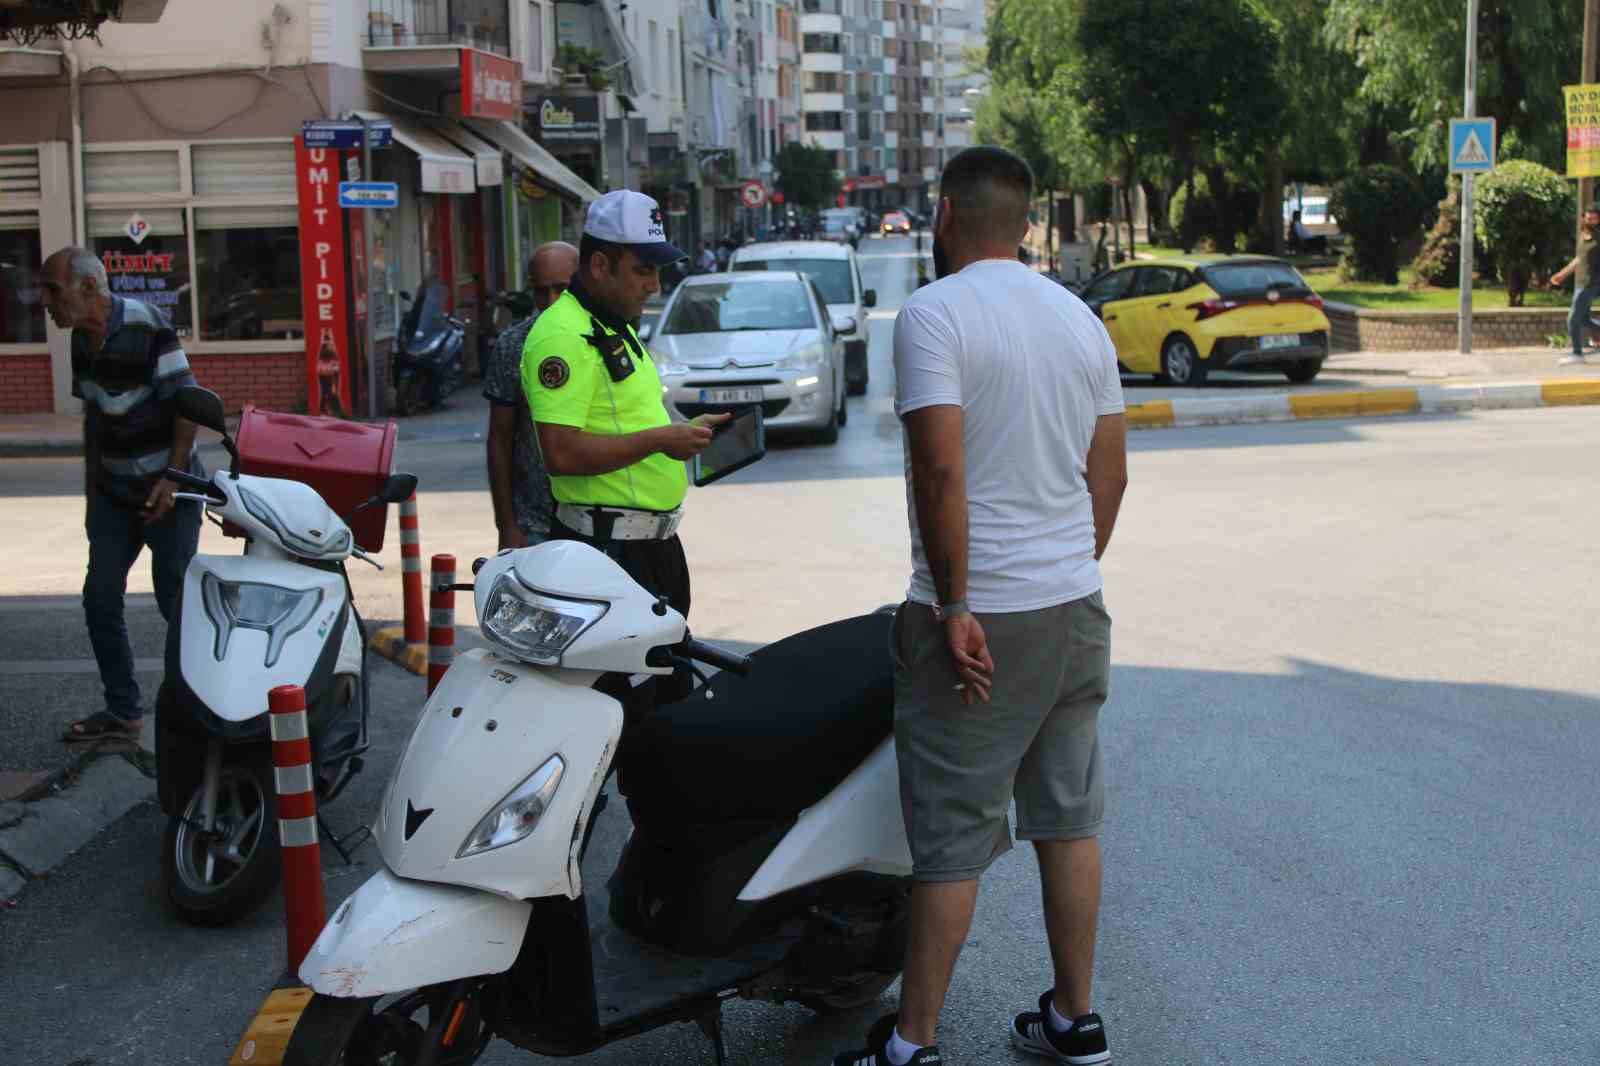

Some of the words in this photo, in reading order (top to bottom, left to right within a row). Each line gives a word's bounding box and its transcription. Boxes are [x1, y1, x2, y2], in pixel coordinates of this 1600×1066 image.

[1569, 115, 1600, 126] FUA
[305, 131, 335, 140] KIBRIS
[1077, 1023, 1100, 1033] adidas
